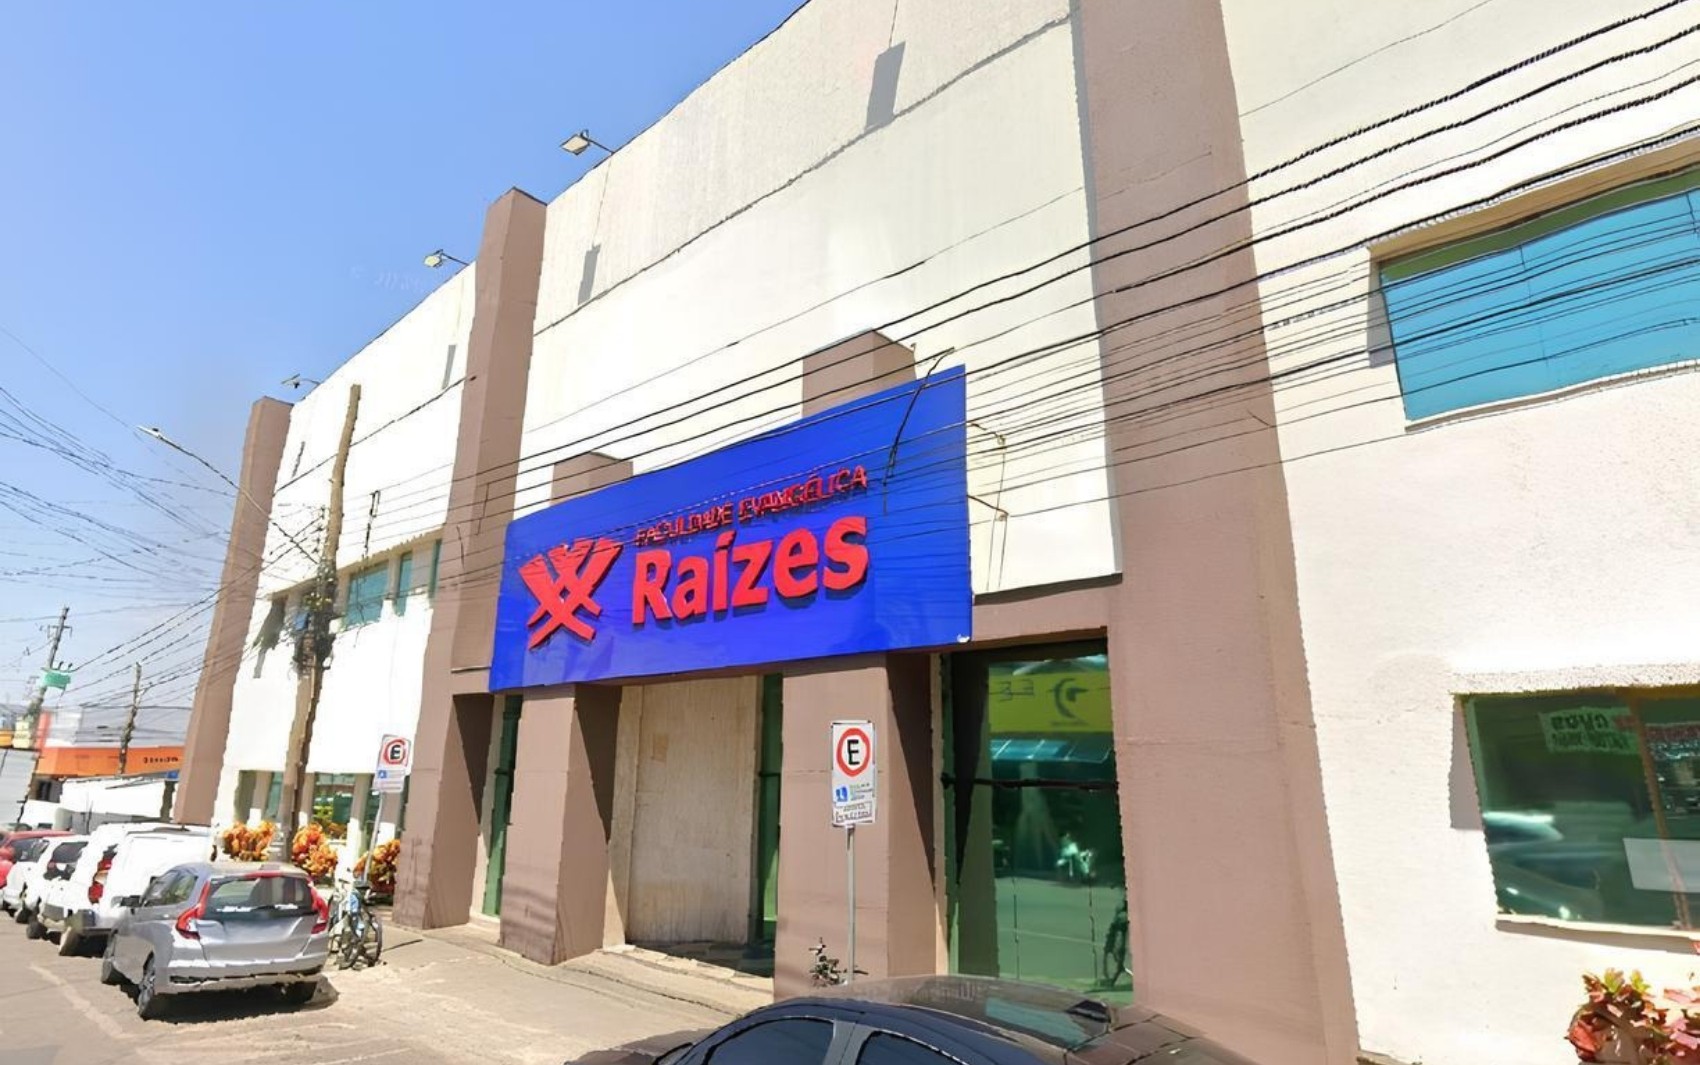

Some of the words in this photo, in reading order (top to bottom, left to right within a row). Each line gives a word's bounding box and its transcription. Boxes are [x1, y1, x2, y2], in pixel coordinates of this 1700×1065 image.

[636, 502, 734, 544] FACULDADE
[739, 466, 867, 520] EVANGÉLICA
[633, 517, 869, 624] Raízes
[391, 745, 401, 760] E
[848, 739, 860, 765] E
